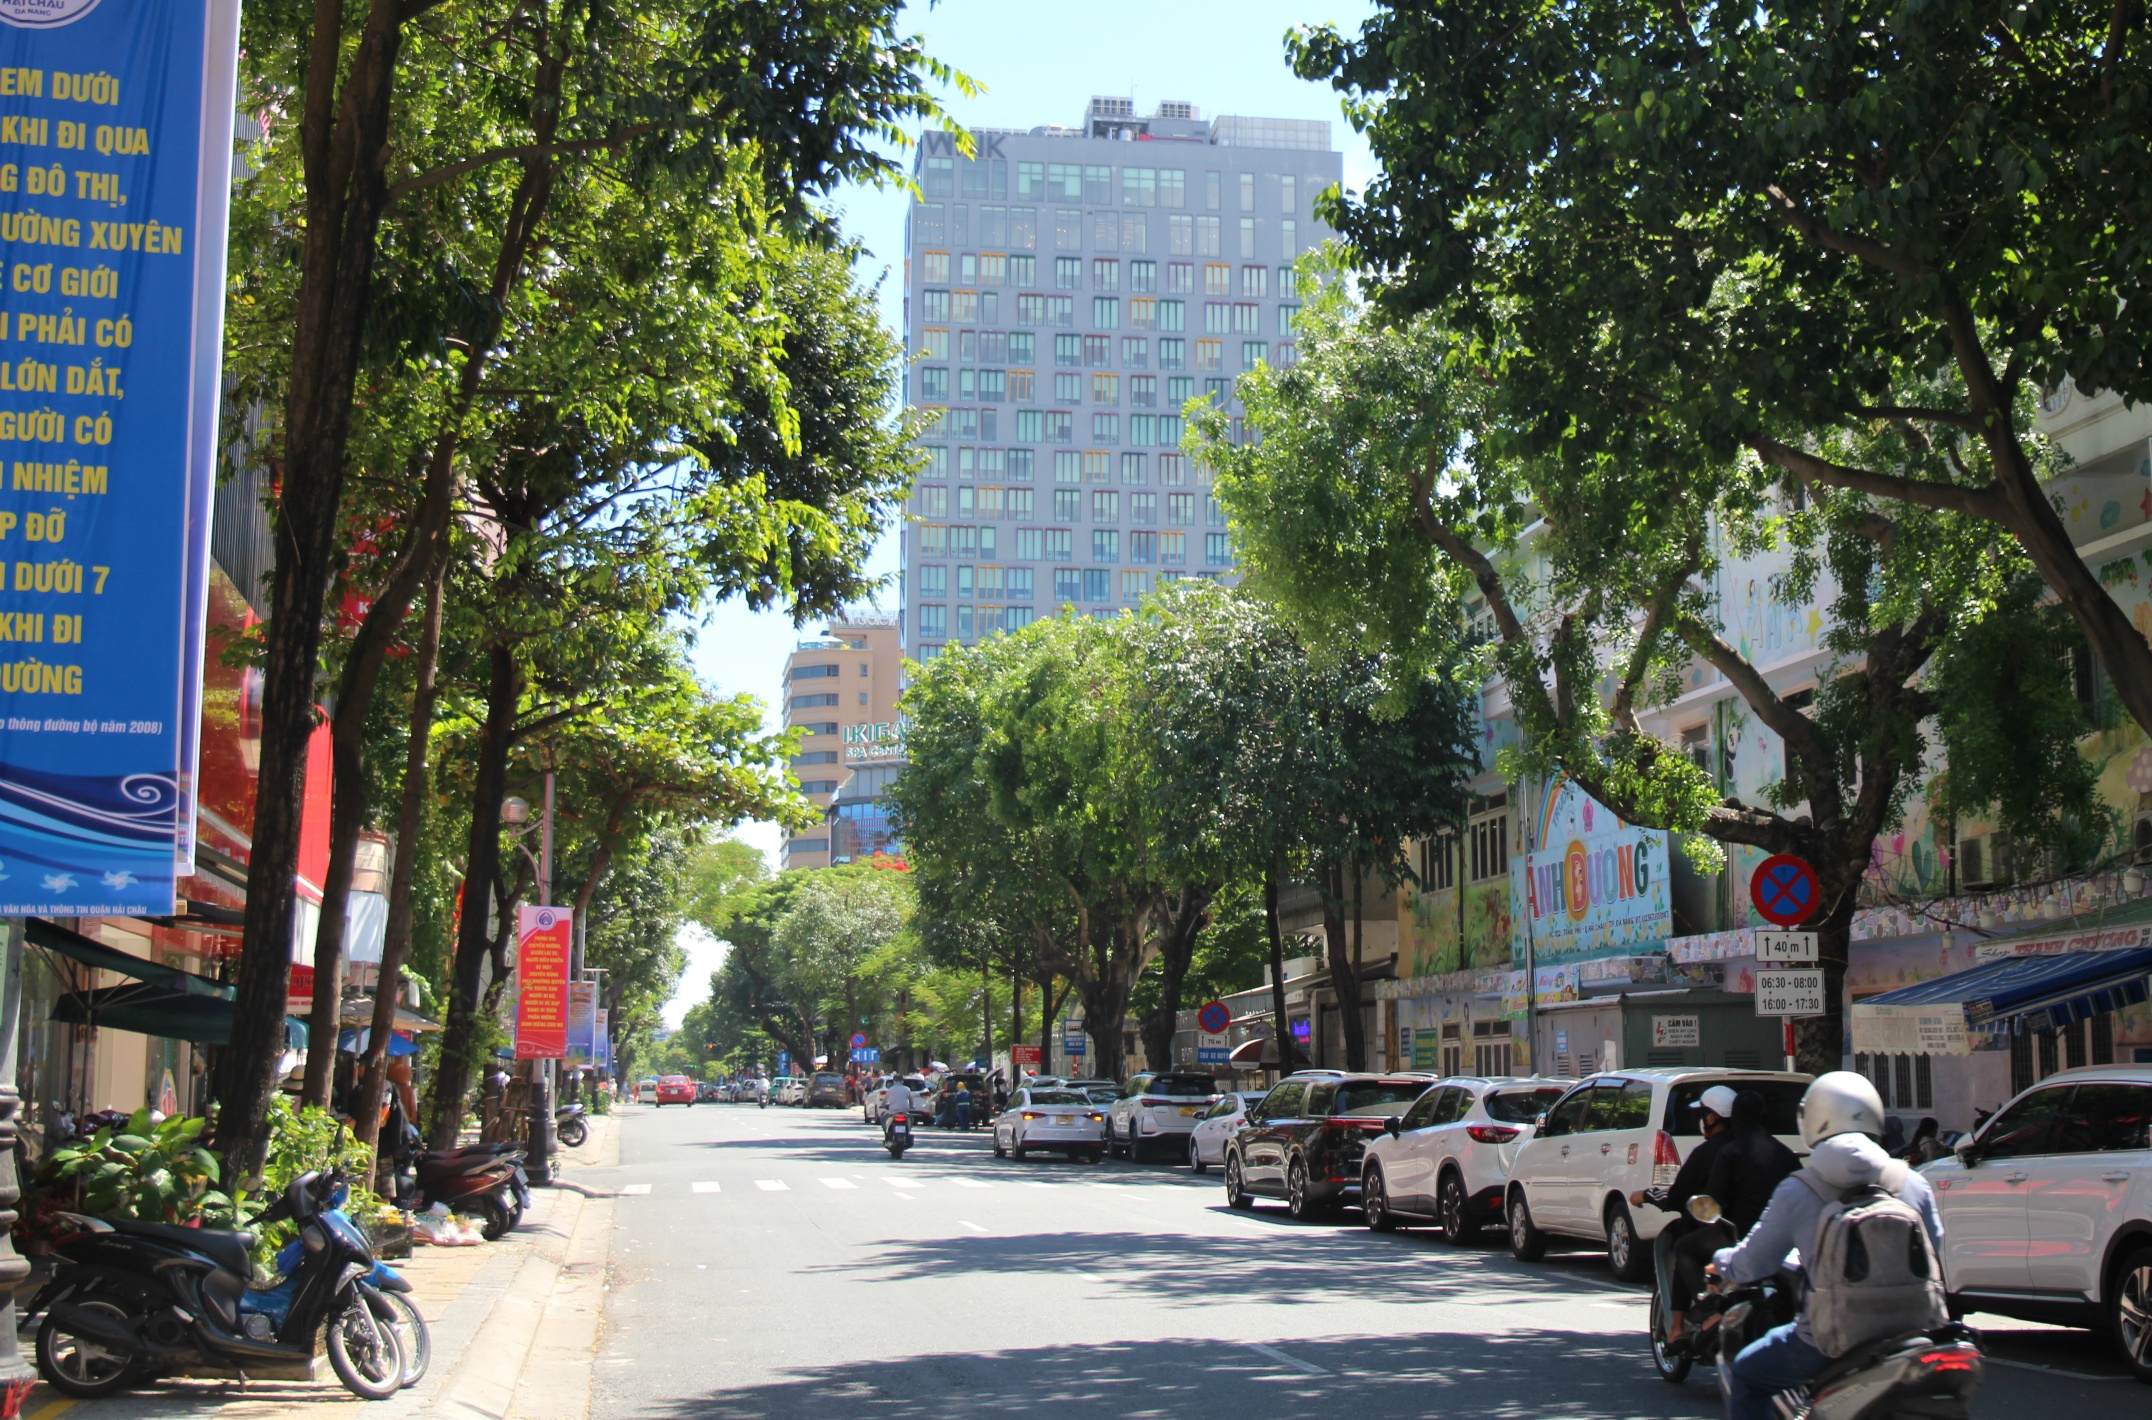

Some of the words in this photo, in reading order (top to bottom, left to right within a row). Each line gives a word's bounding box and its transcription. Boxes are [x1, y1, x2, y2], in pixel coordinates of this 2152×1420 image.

[1, 68, 43, 98] EM
[53, 70, 120, 106] DƯỚI
[2, 116, 48, 147] KHI
[57, 121, 86, 150] ĐI
[95, 127, 149, 157] QUA
[925, 132, 1006, 159] WNK
[27, 163, 66, 197] ĐÔ
[75, 171, 127, 208] THỊ,
[89, 220, 182, 255] XUYÊN
[13, 263, 52, 294] CƠ
[60, 264, 119, 299] GIỚI
[18, 307, 86, 346] PHẢI
[95, 313, 133, 348] CÓ
[1, 357, 57, 393] LỚN
[66, 357, 124, 400] DẮT,
[75, 411, 113, 445] CÓ
[13, 459, 108, 500] NHIỆM
[25, 507, 67, 543] ĐỠ
[15, 558, 83, 594] DƯỚI
[92, 566, 110, 595] 7
[0, 612, 43, 643] KHI
[53, 614, 82, 644] ĐI
[0, 657, 83, 695] ƯỜNG
[8, 717, 41, 733] thông
[43, 718, 80, 733] đường
[83, 719, 98, 735] bộ
[101, 720, 126, 733] năm
[129, 721, 163, 735] 2008)
[3, 904, 19, 914] VĂN
[20, 903, 36, 914] HÓA
[38, 903, 48, 914] VÀ
[50, 904, 75, 914] THÔNG
[76, 905, 89, 914] TIN
[90, 904, 111, 916] QUẬN
[112, 904, 125, 915] HẢI
[126, 904, 147, 915] CHÂU
[1774, 941, 1787, 952] 40
[1790, 943, 1800, 953] m
[1761, 977, 1786, 989] 06:30
[1793, 977, 1818, 989] 08:00
[1762, 998, 1787, 1010] 16:00
[1795, 998, 1820, 1010] 17:30
